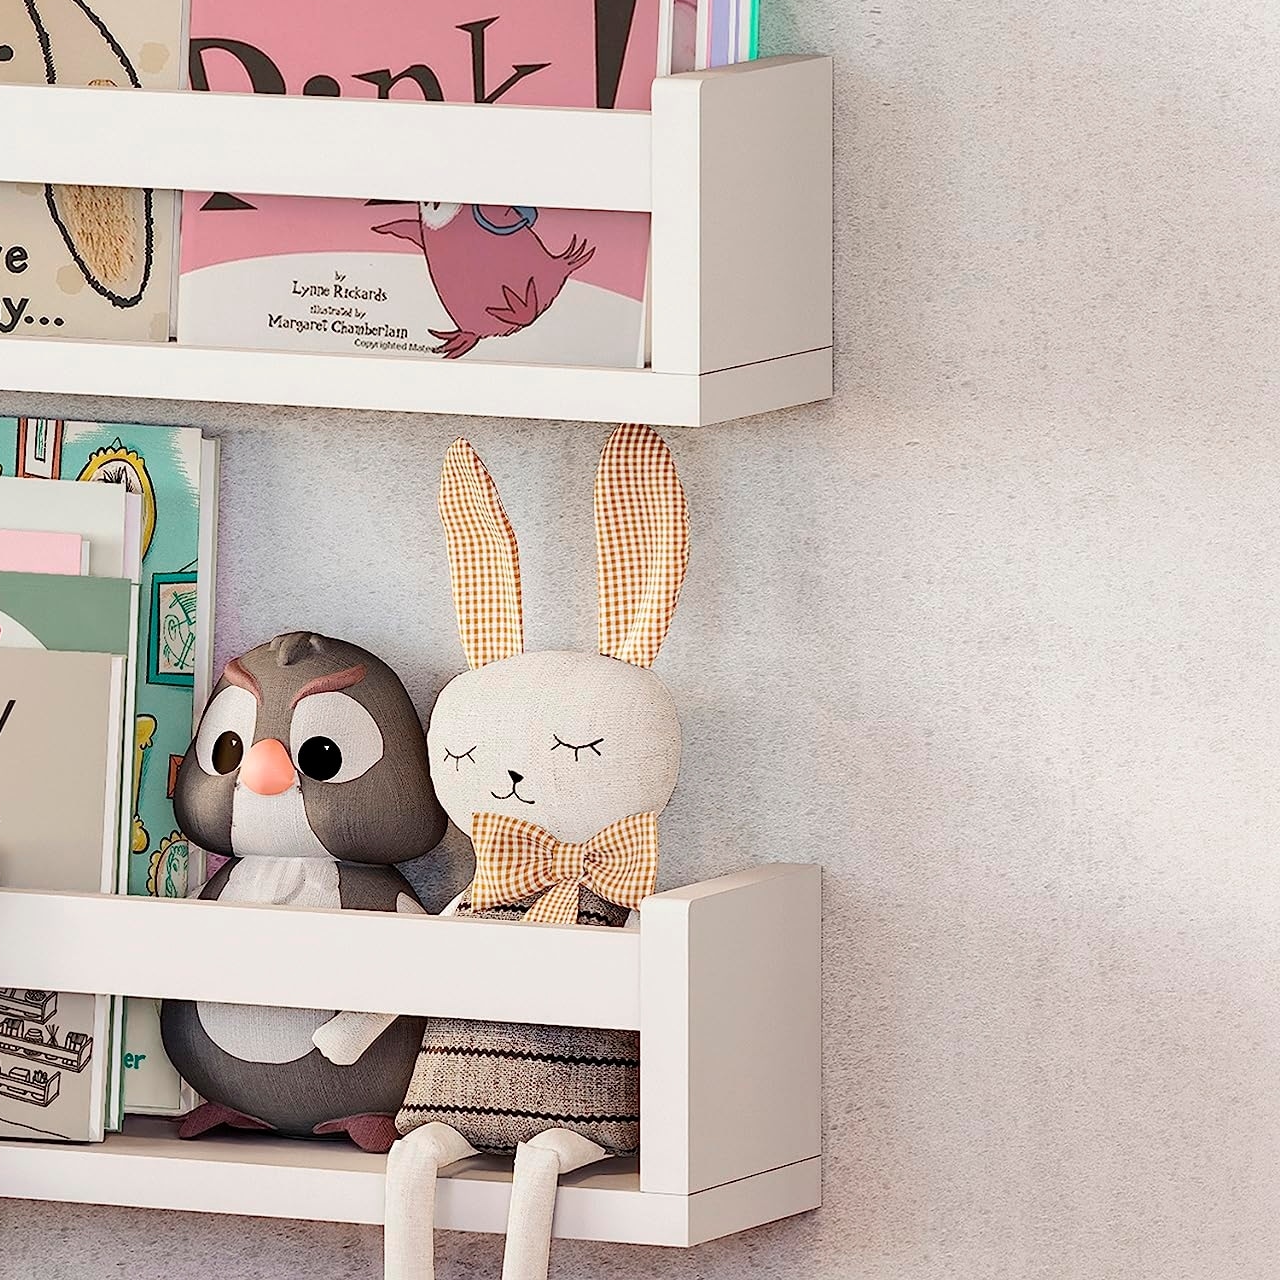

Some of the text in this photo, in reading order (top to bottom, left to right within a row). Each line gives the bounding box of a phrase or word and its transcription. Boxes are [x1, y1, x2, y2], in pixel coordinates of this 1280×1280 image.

[335, 271, 346, 282] by
[292, 280, 388, 302] Lynne Rickards
[355, 308, 367, 319] by
[268, 313, 408, 339] Margaret Chamberlain
[354, 338, 408, 351] Copyrighted
